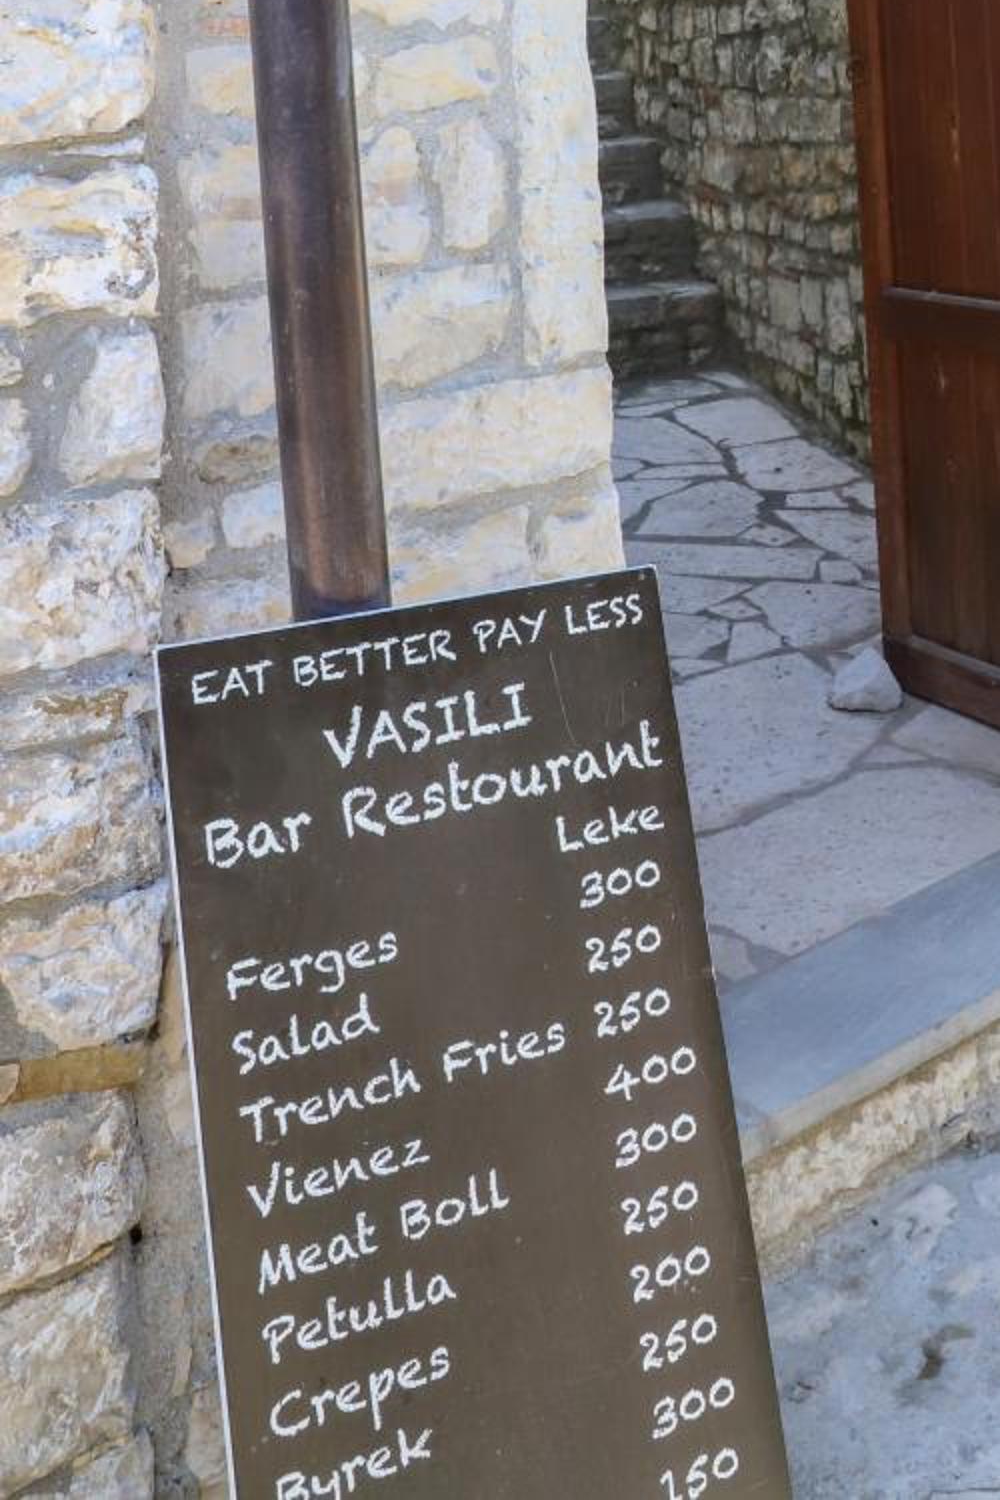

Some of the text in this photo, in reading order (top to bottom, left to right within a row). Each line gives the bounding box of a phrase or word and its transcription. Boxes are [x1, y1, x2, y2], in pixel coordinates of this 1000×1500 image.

[191, 594, 643, 704] EAT BETTER PAY LESS
[325, 683, 533, 768] VASILI
[204, 719, 663, 868] Bar Restourant
[556, 804, 665, 853] Leke
[581, 860, 660, 909] 300
[227, 932, 398, 999] Ferges
[586, 925, 661, 973] 250
[232, 993, 380, 1075] Salad
[595, 988, 671, 1039] 250
[239, 1022, 566, 1142] Trench Fries
[605, 1046, 696, 1100] 400
[616, 1114, 697, 1168] 300
[248, 1138, 430, 1218] Vienez
[621, 1181, 699, 1235] 250
[258, 1168, 510, 1294] Meat Boll
[630, 1245, 711, 1302] 200
[261, 1271, 457, 1364] Petulla
[640, 1313, 717, 1371] 250
[269, 1344, 450, 1436] Crepes
[652, 1377, 735, 1439] 300
[275, 1428, 432, 1500] Byrek
[659, 1448, 739, 1500] 150
